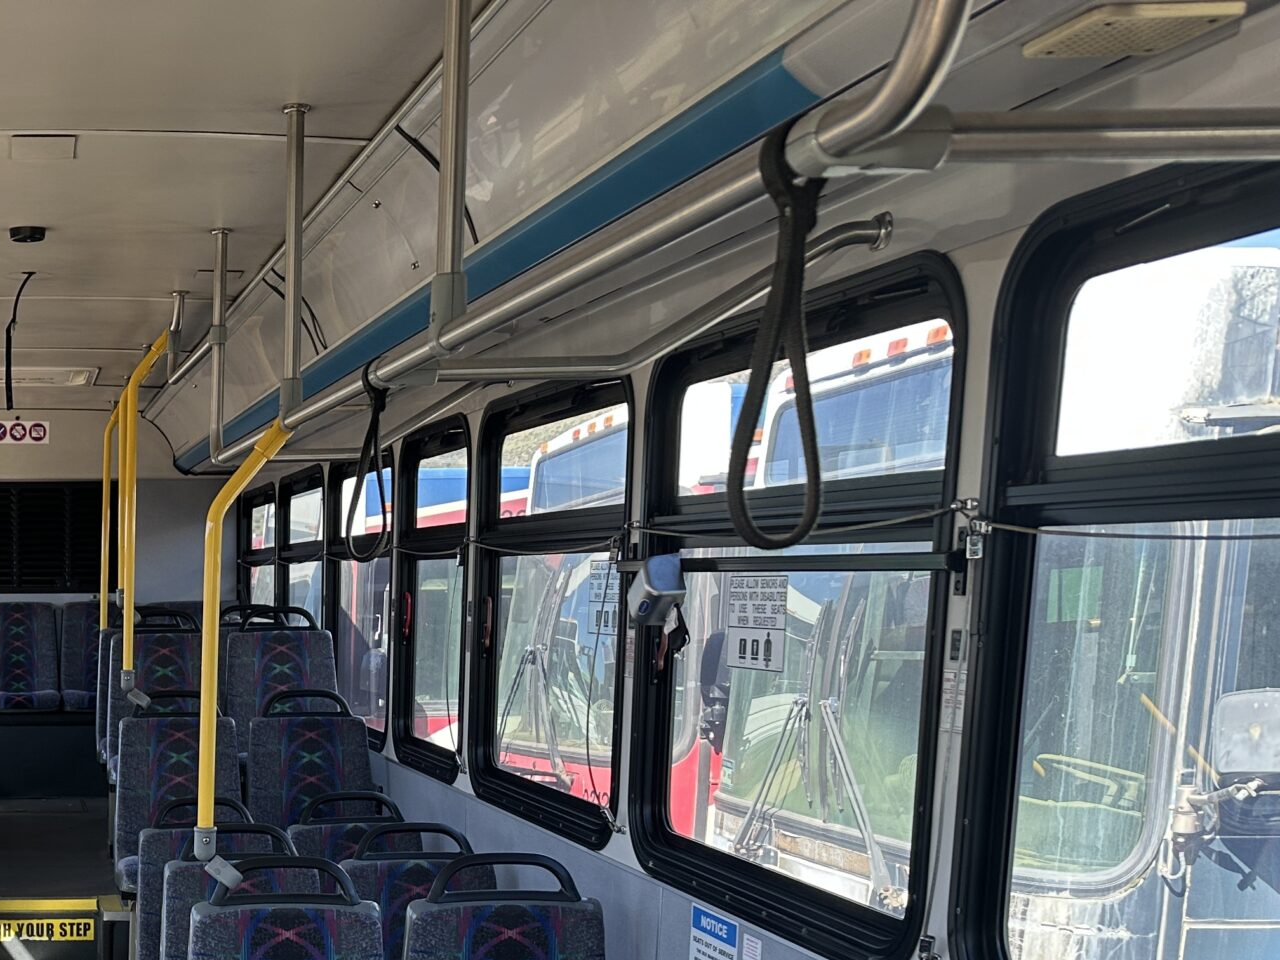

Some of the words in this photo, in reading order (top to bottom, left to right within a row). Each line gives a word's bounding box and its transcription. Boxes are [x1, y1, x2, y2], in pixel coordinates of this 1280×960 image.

[17, 922, 54, 938] YOUR
[59, 922, 91, 937] STEP
[701, 914, 728, 939] NOTICE
